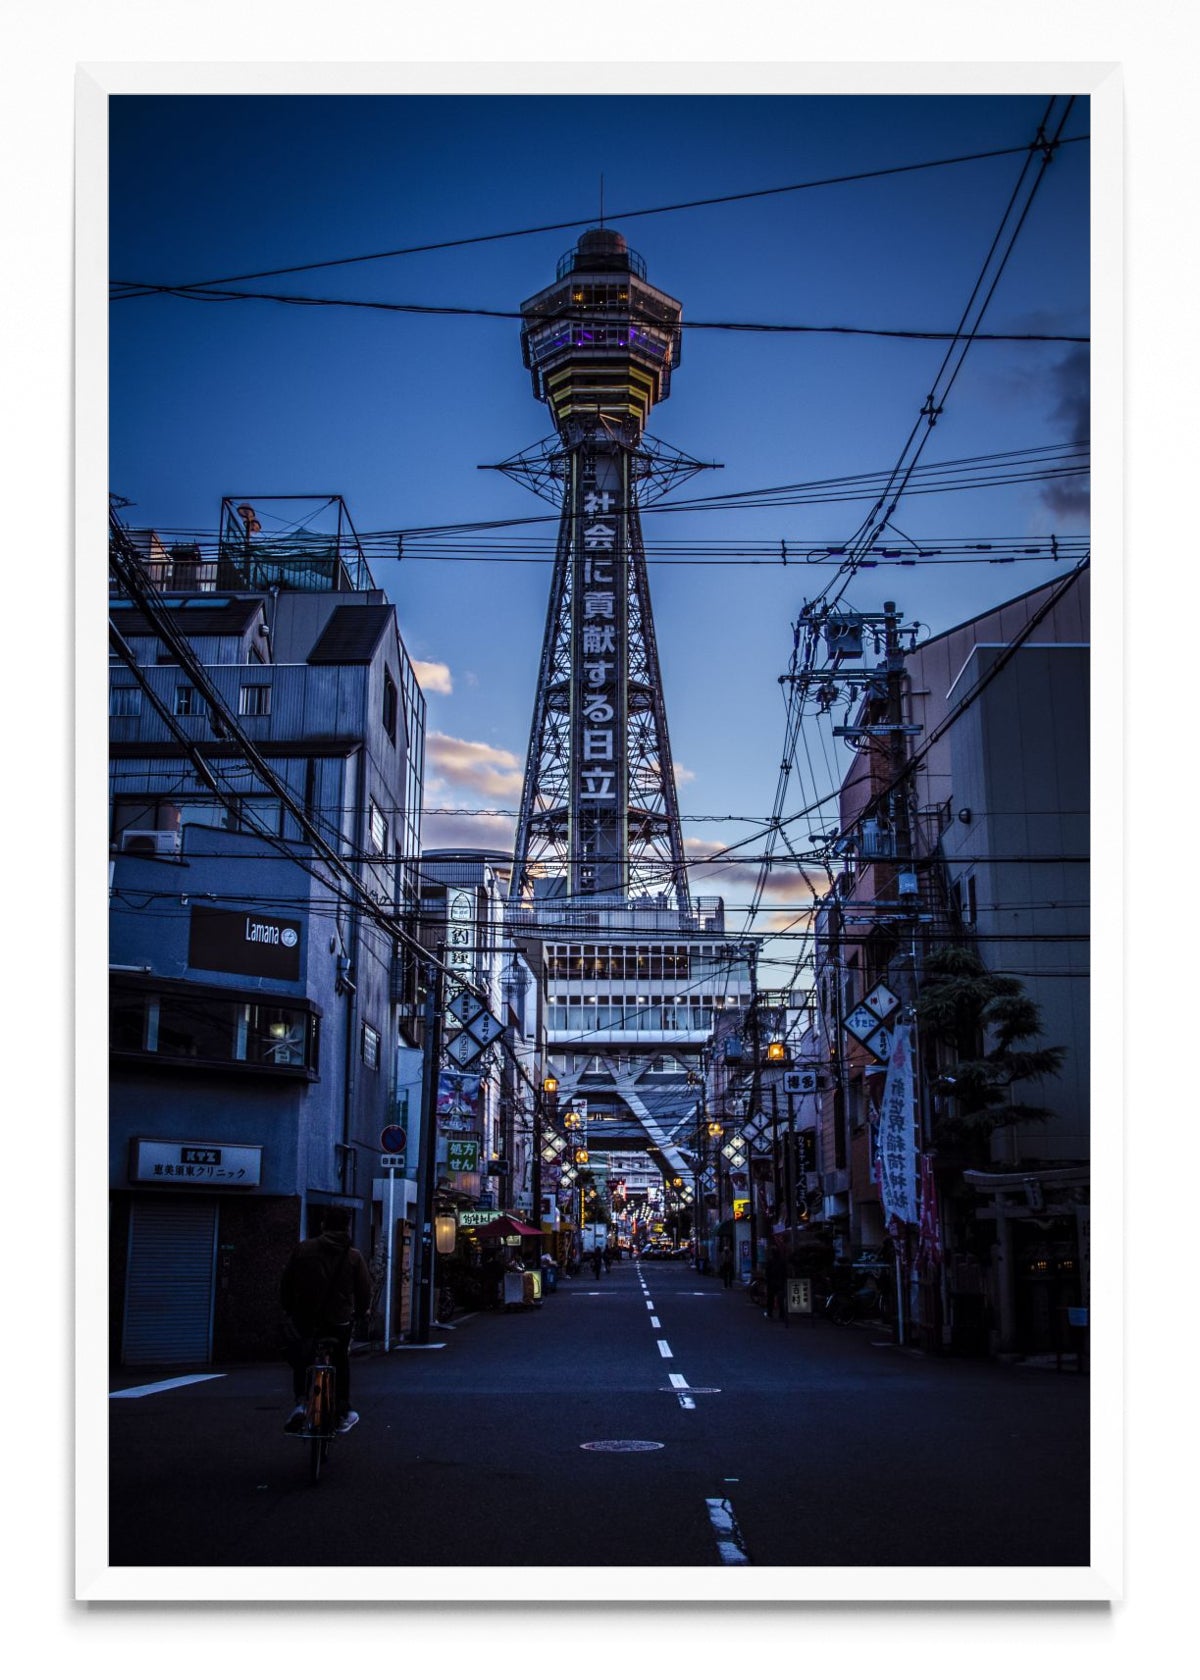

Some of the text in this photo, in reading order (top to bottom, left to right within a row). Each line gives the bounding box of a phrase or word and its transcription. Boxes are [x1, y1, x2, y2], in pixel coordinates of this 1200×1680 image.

[582, 491, 616, 799] 社会に貢献する日立
[245, 917, 279, 945] Lamana
[450, 1143, 476, 1155] 処方
[449, 1159, 474, 1171] せん
